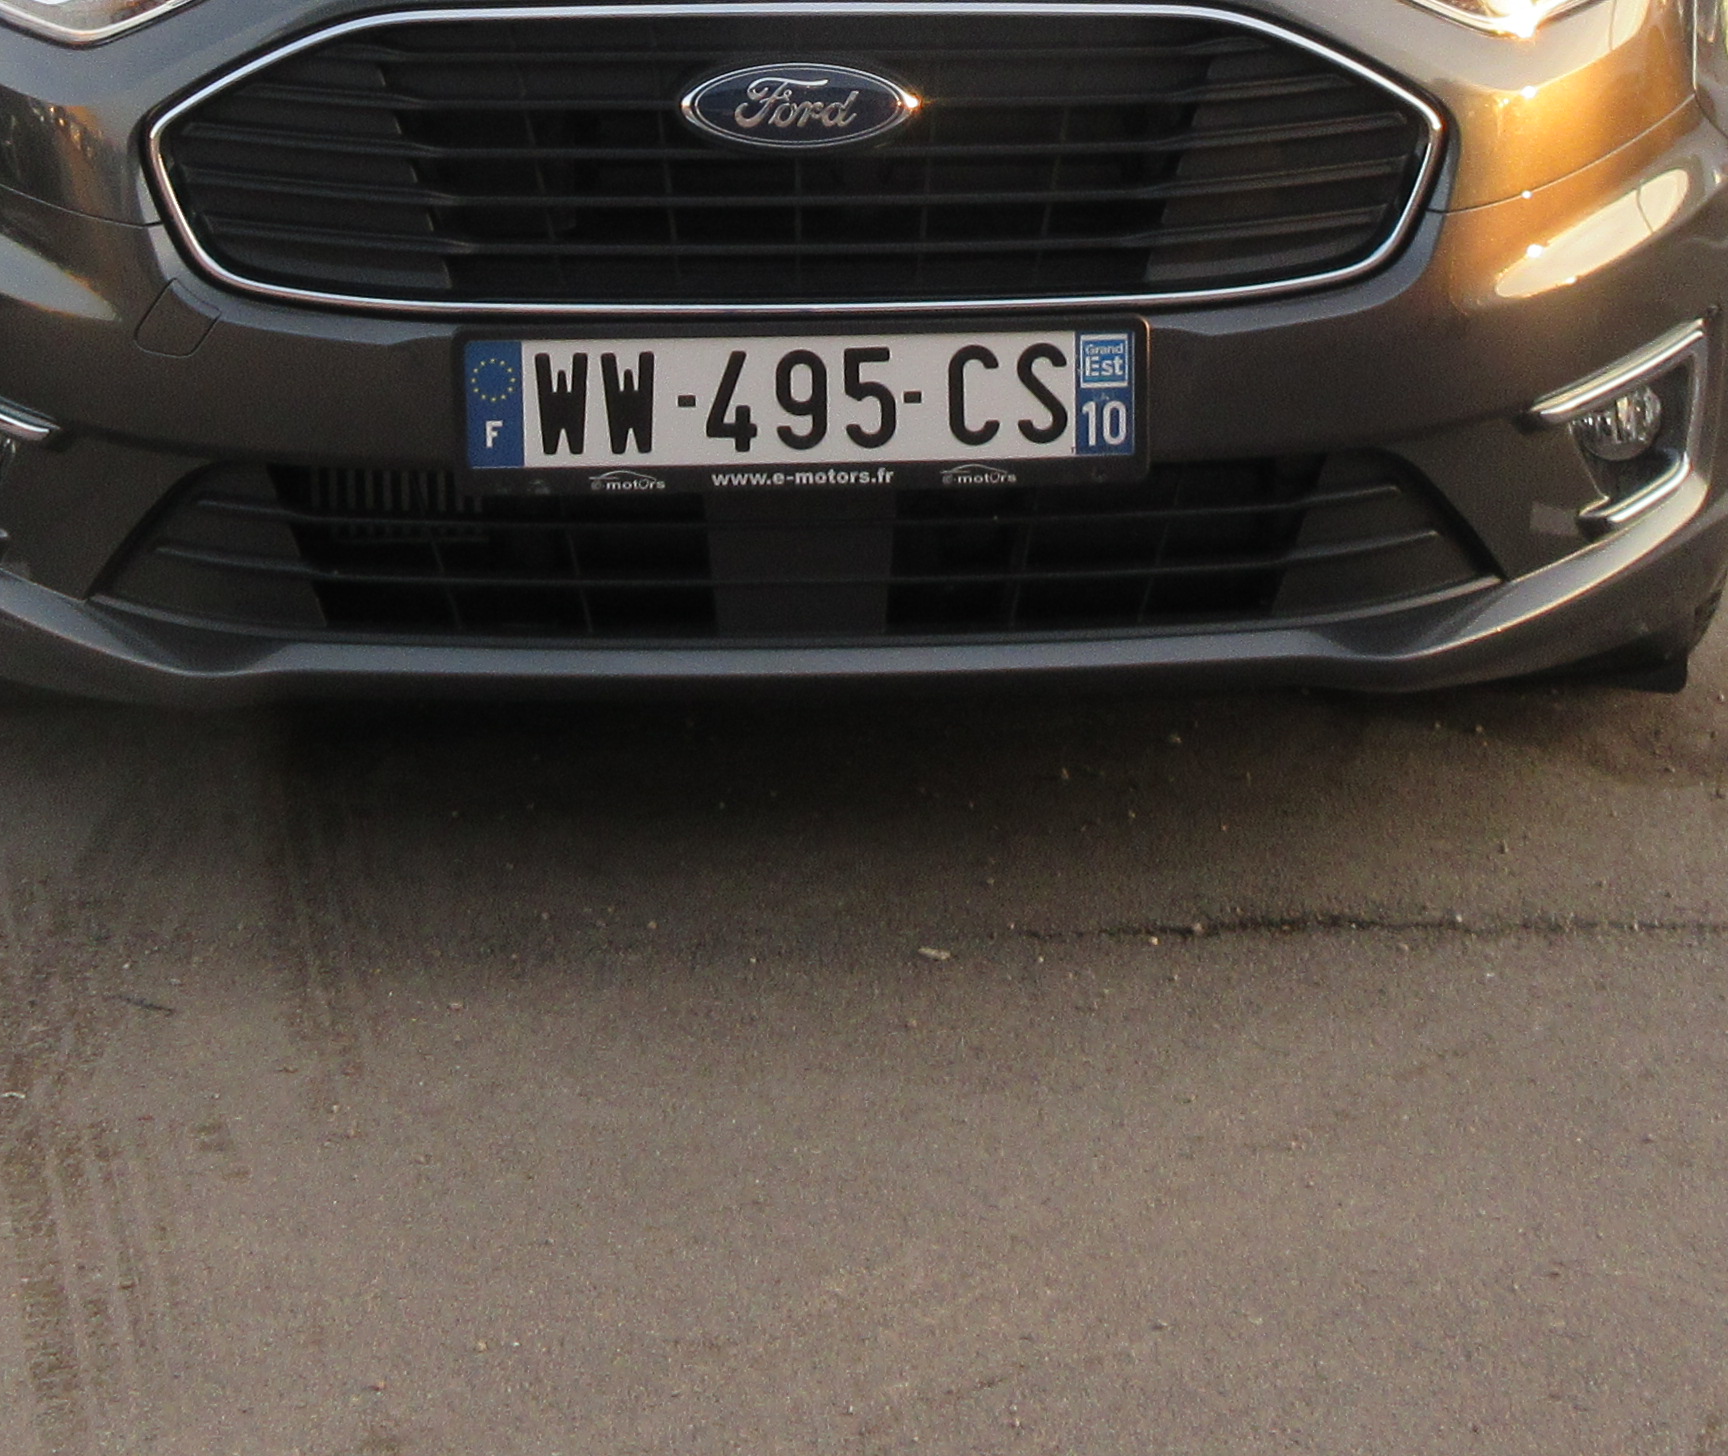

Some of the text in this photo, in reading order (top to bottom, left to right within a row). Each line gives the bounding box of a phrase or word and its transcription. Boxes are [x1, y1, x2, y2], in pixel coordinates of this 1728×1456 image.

[734, 76, 860, 129] Ford
[1084, 342, 1124, 355] Grand
[1084, 355, 1124, 377] Est
[485, 419, 504, 449] F
[1081, 400, 1127, 447] 10
[711, 467, 894, 487] www.e-motors.fr
